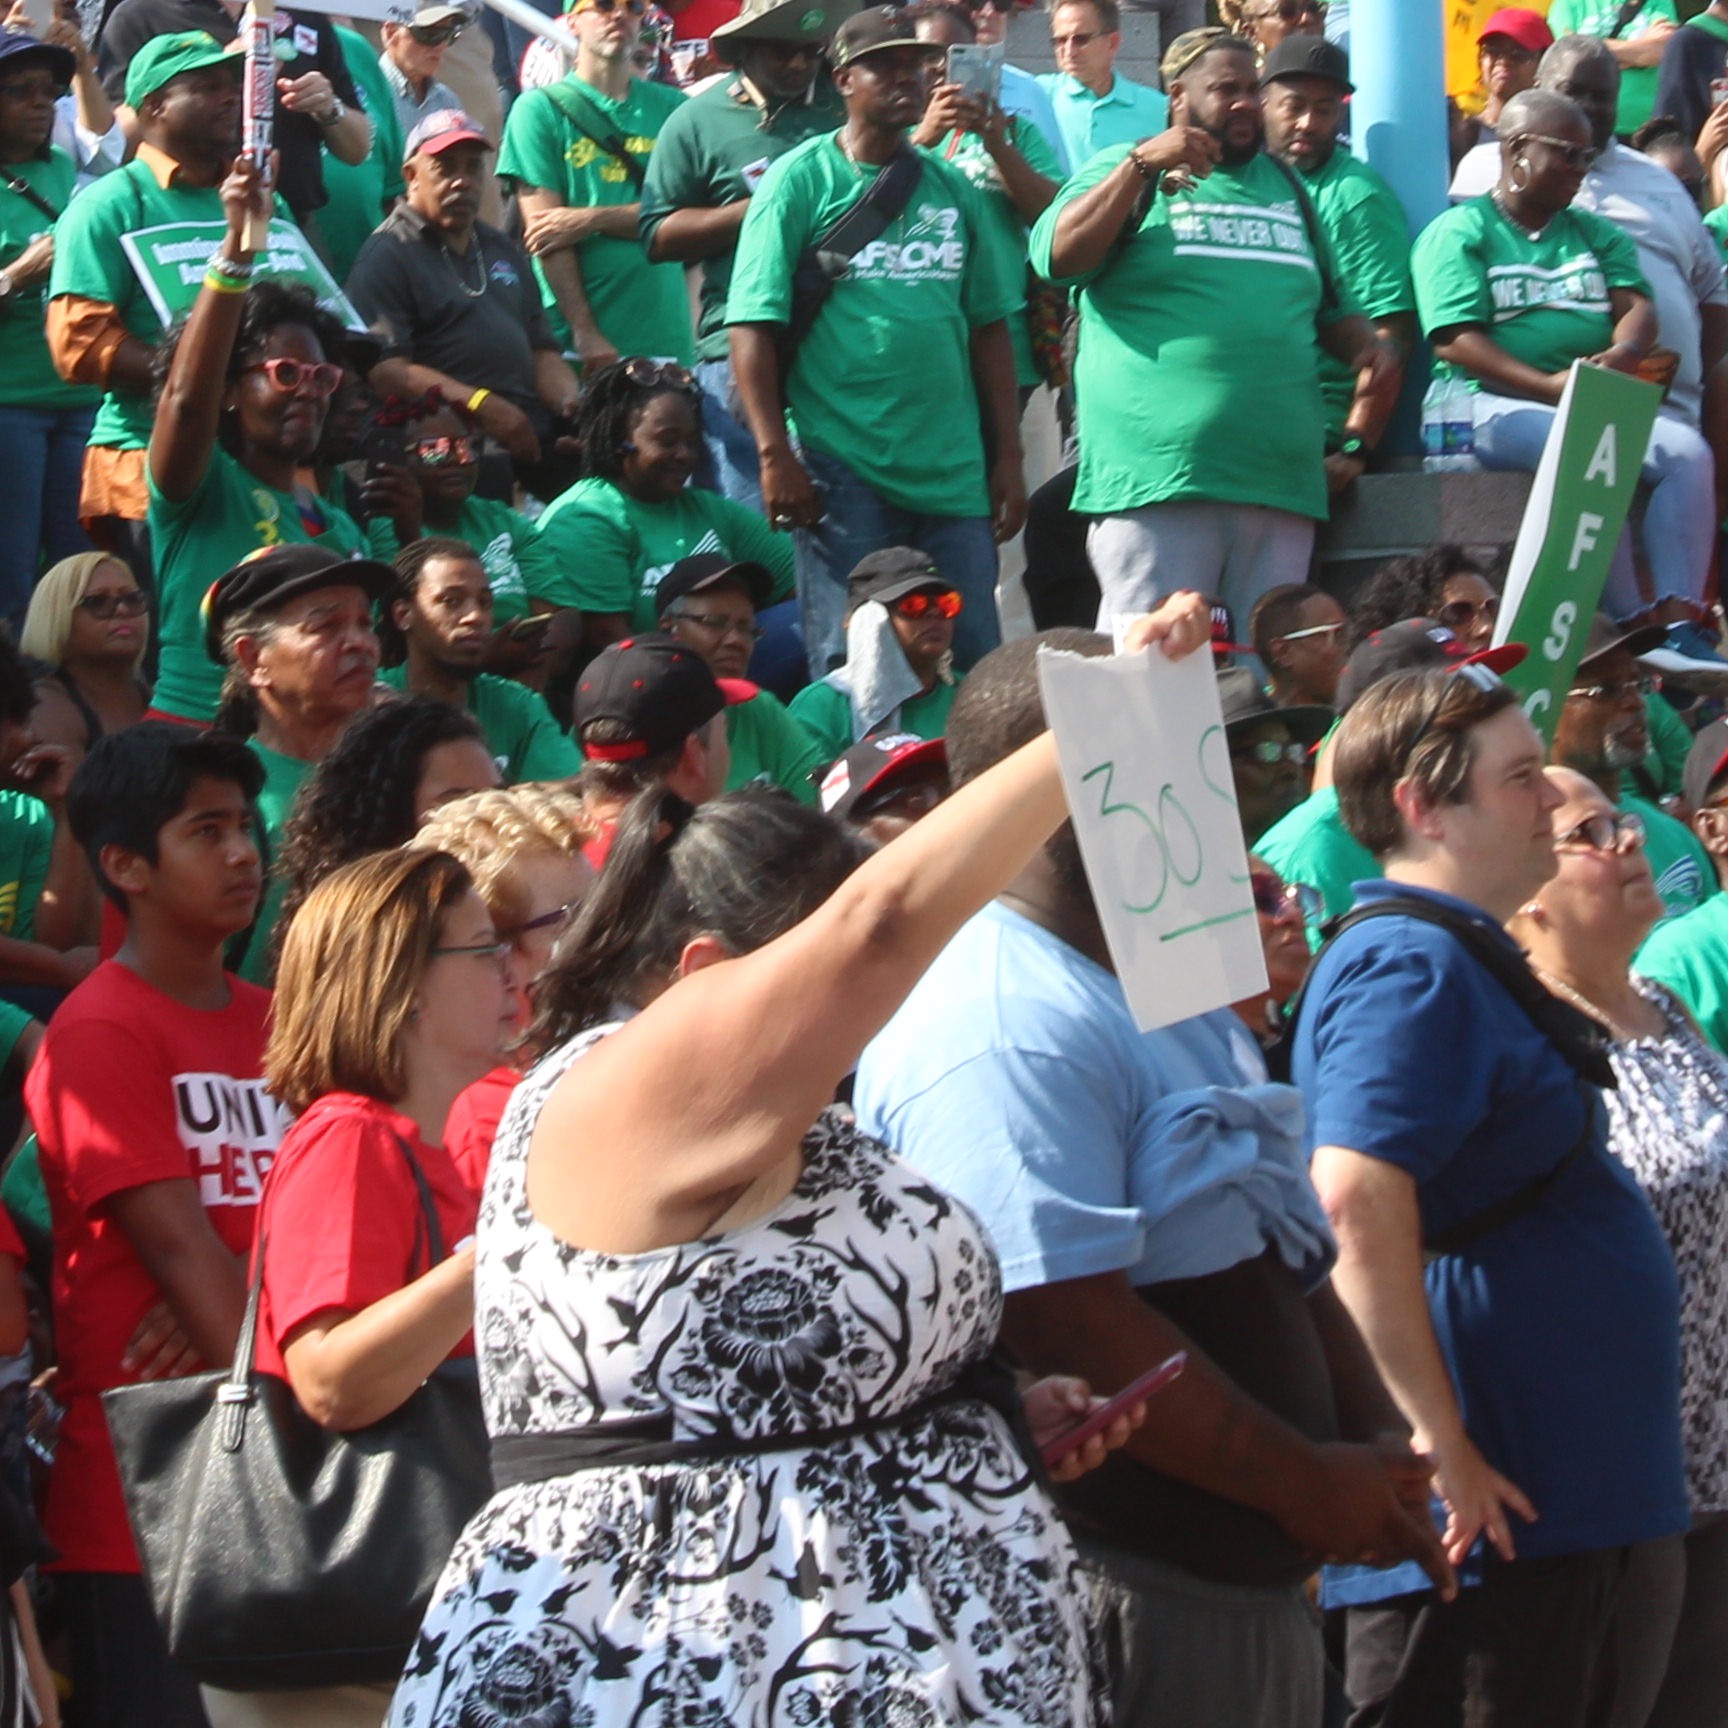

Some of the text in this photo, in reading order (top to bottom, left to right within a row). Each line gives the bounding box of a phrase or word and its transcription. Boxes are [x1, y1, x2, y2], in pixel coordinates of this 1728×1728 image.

[848, 241, 964, 270] AFSCME
[1521, 423, 1617, 735] AFSC
[178, 1078, 273, 1138] UNIT
[188, 1144, 276, 1203] HER
